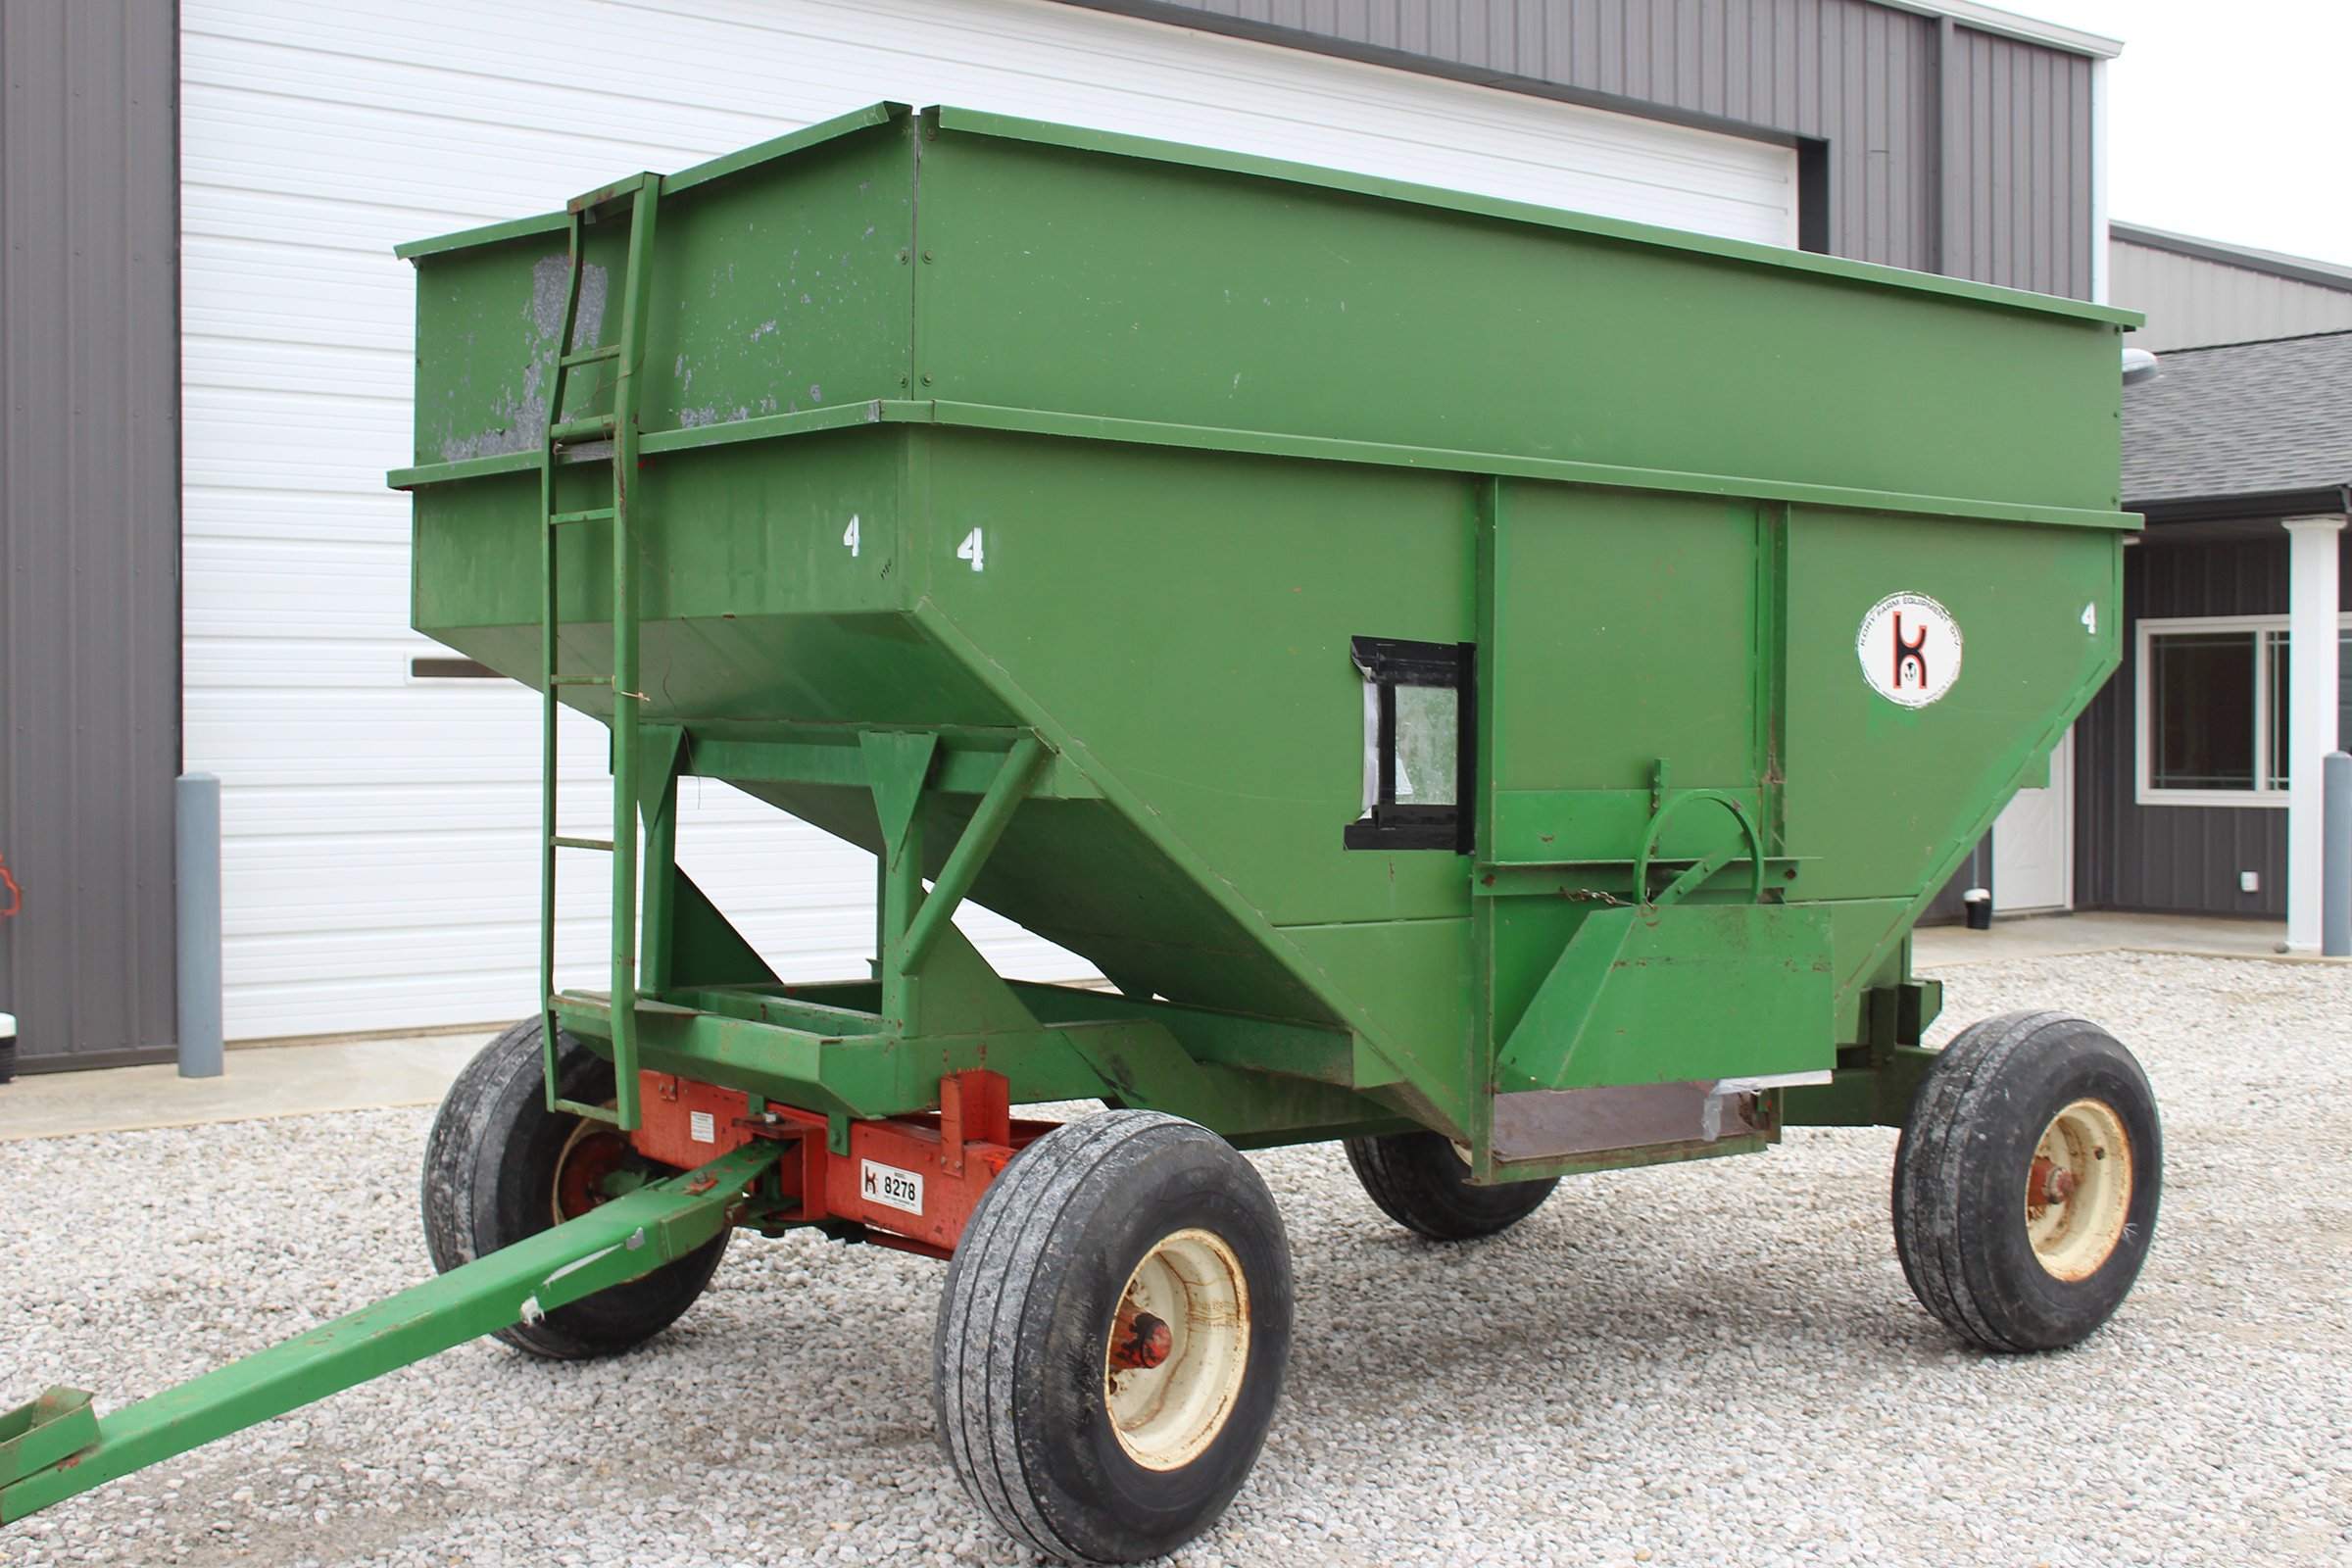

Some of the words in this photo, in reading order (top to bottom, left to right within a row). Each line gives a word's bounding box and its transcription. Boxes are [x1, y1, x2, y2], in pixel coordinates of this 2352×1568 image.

[843, 514, 859, 557] 4
[956, 526, 984, 572] 4
[1876, 599, 1900, 617] FARM
[1902, 597, 1949, 623] EQUIPMENT
[2081, 601, 2096, 635] 4
[884, 1175, 915, 1201] 8278
